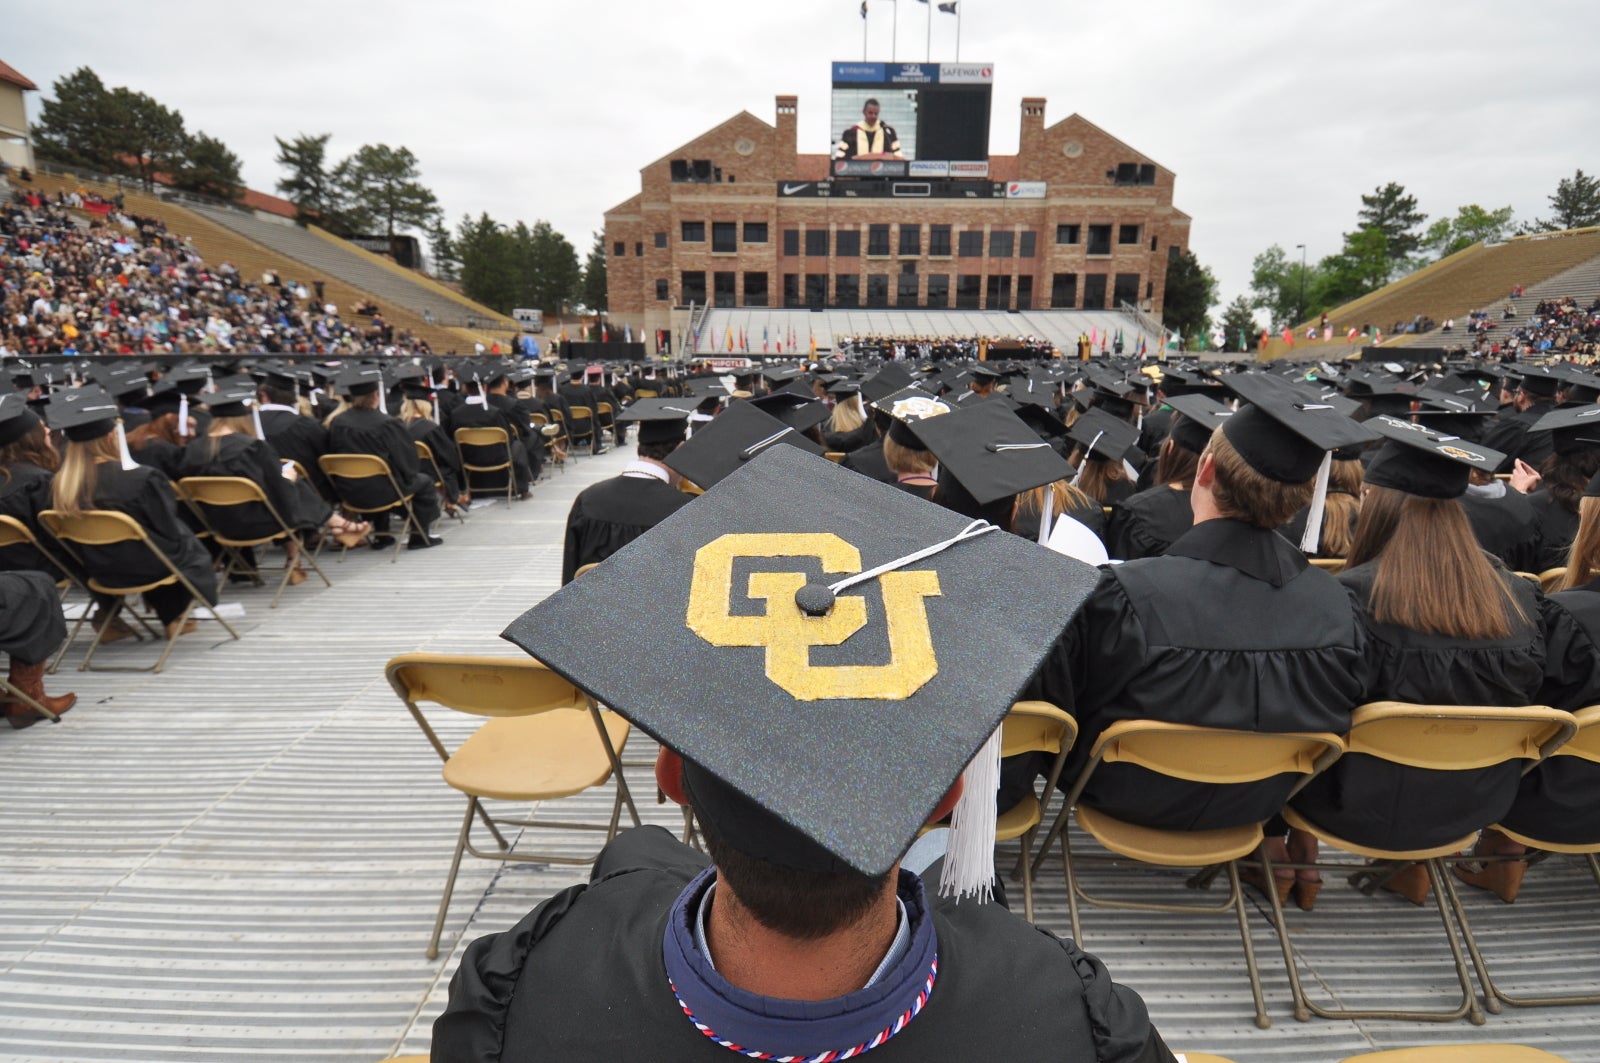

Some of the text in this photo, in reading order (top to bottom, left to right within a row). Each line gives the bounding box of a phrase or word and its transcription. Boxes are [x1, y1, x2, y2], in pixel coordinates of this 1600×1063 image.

[942, 68, 980, 77] SAFEWAY
[706, 360, 747, 368] HIPOTLE
[686, 532, 942, 701] CU
